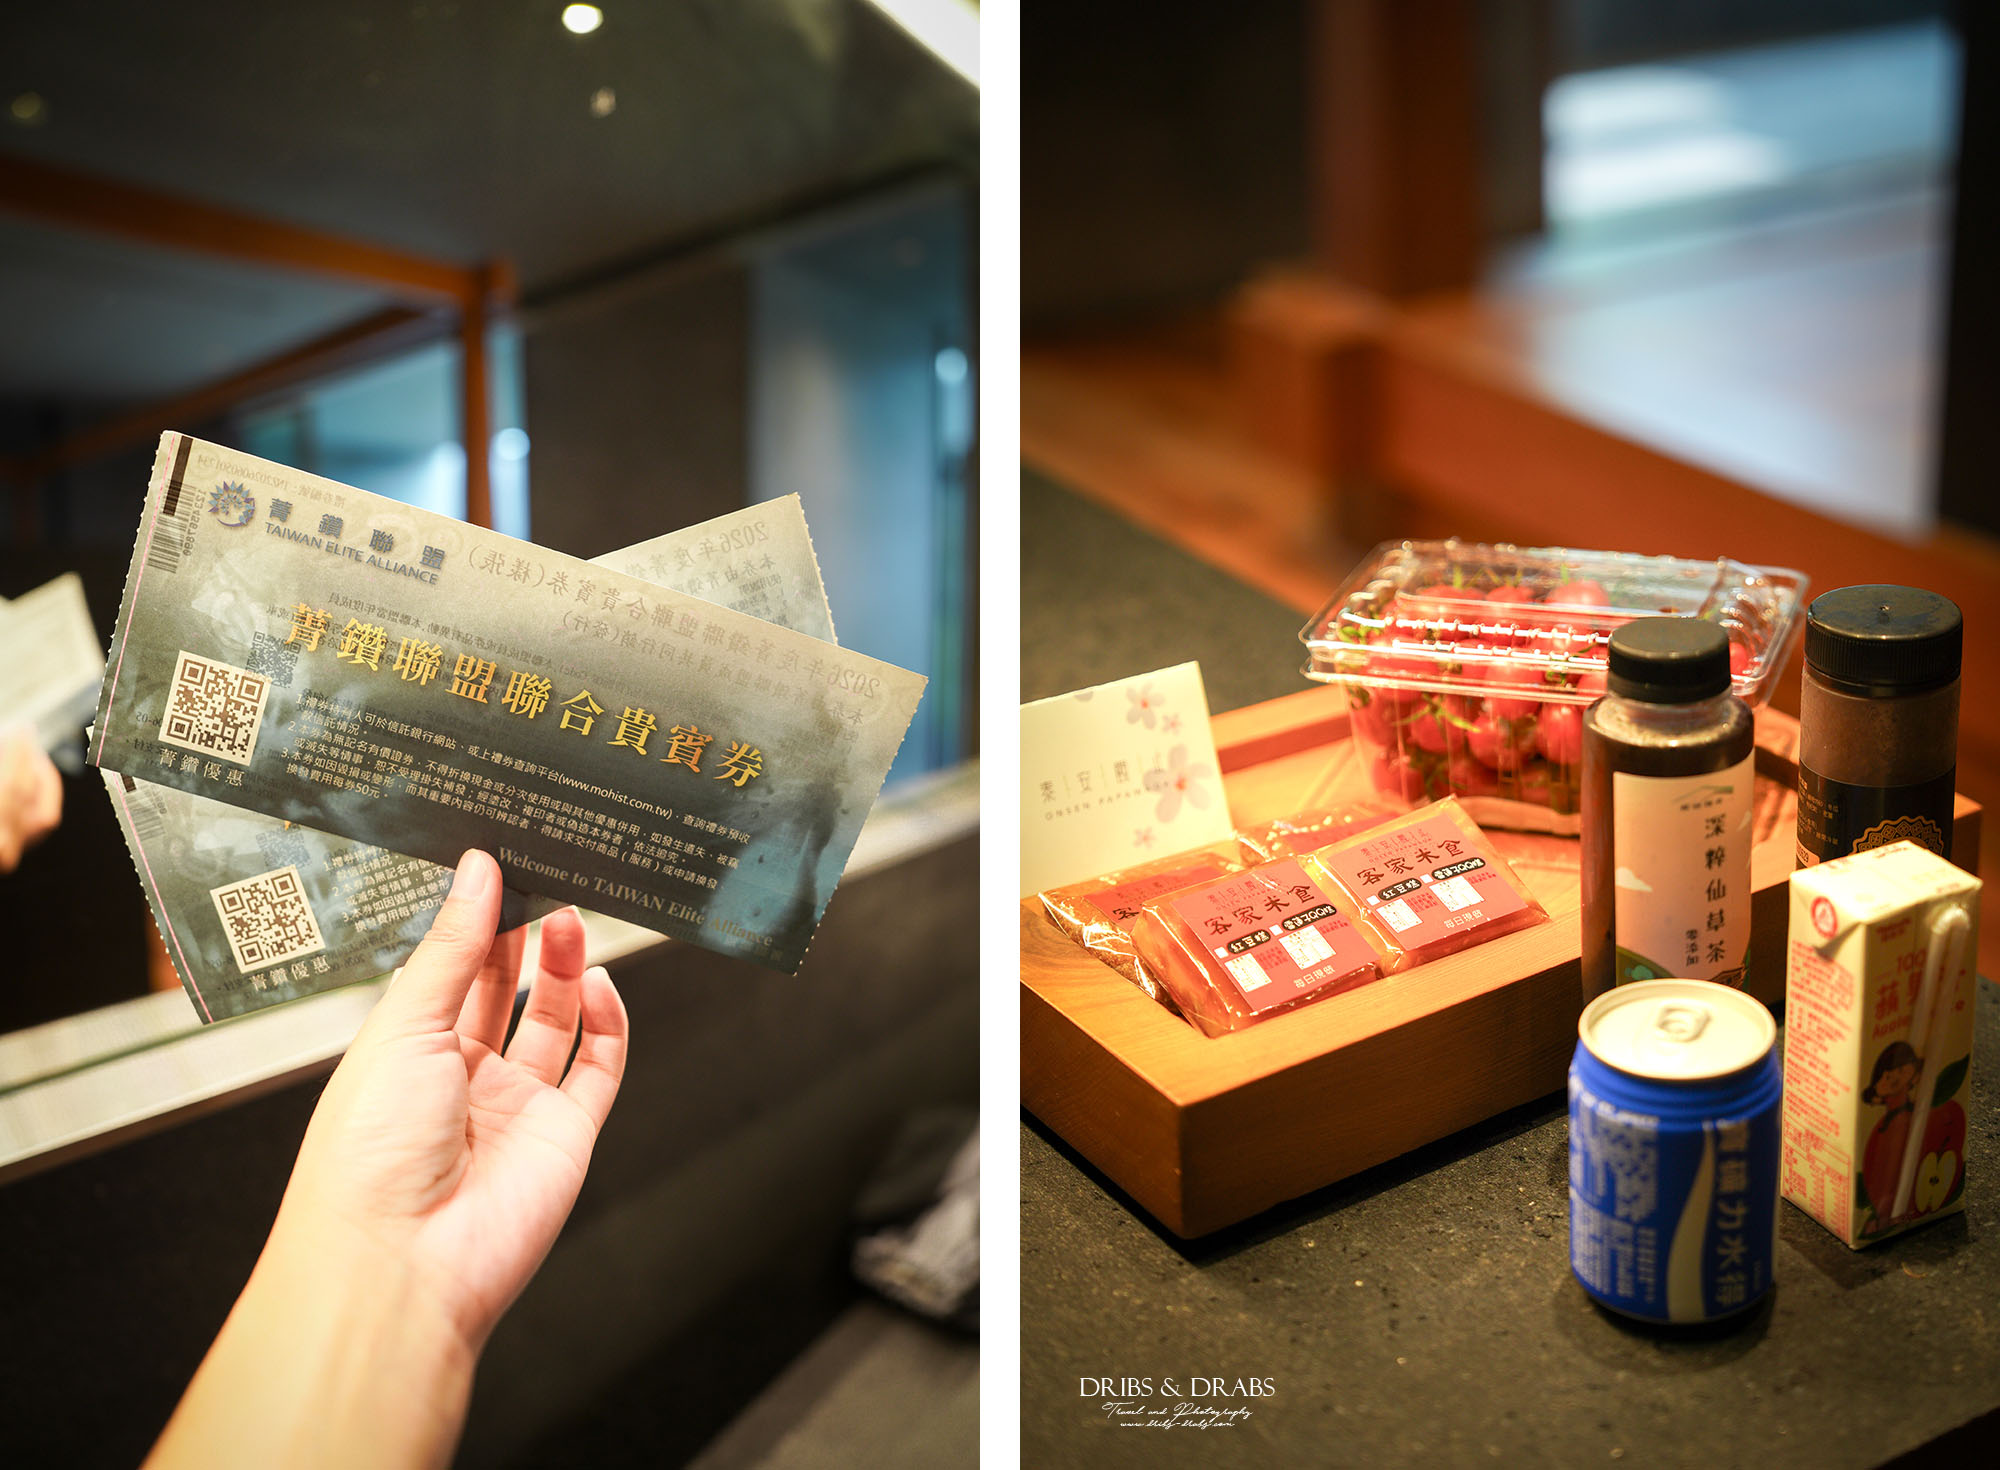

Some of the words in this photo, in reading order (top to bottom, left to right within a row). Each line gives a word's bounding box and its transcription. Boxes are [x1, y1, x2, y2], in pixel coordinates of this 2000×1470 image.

[262, 523, 323, 550] TAIWAN
[324, 541, 364, 563] ELITE
[365, 553, 438, 586] ALLIANCE
[266, 497, 446, 570] 菁鑽聯盟
[280, 599, 768, 792] 菁鑽聯盟聯合貴賓券
[155, 746, 247, 788] 菁鑽優惠
[1356, 836, 1464, 888] 客家米食
[1704, 813, 1727, 965] 深粹仙草茶
[496, 846, 569, 881] Welcome
[571, 871, 589, 887] to
[591, 876, 665, 912] TAIWAN
[666, 900, 707, 926] Elite
[708, 913, 775, 947] Alliance
[1203, 881, 1315, 938] 客家米食
[1443, 908, 1483, 930] 每日現做
[1230, 928, 1270, 953] 紅豆糕
[248, 954, 331, 992] 菁鑽優惠
[1292, 963, 1336, 989] 每日現做
